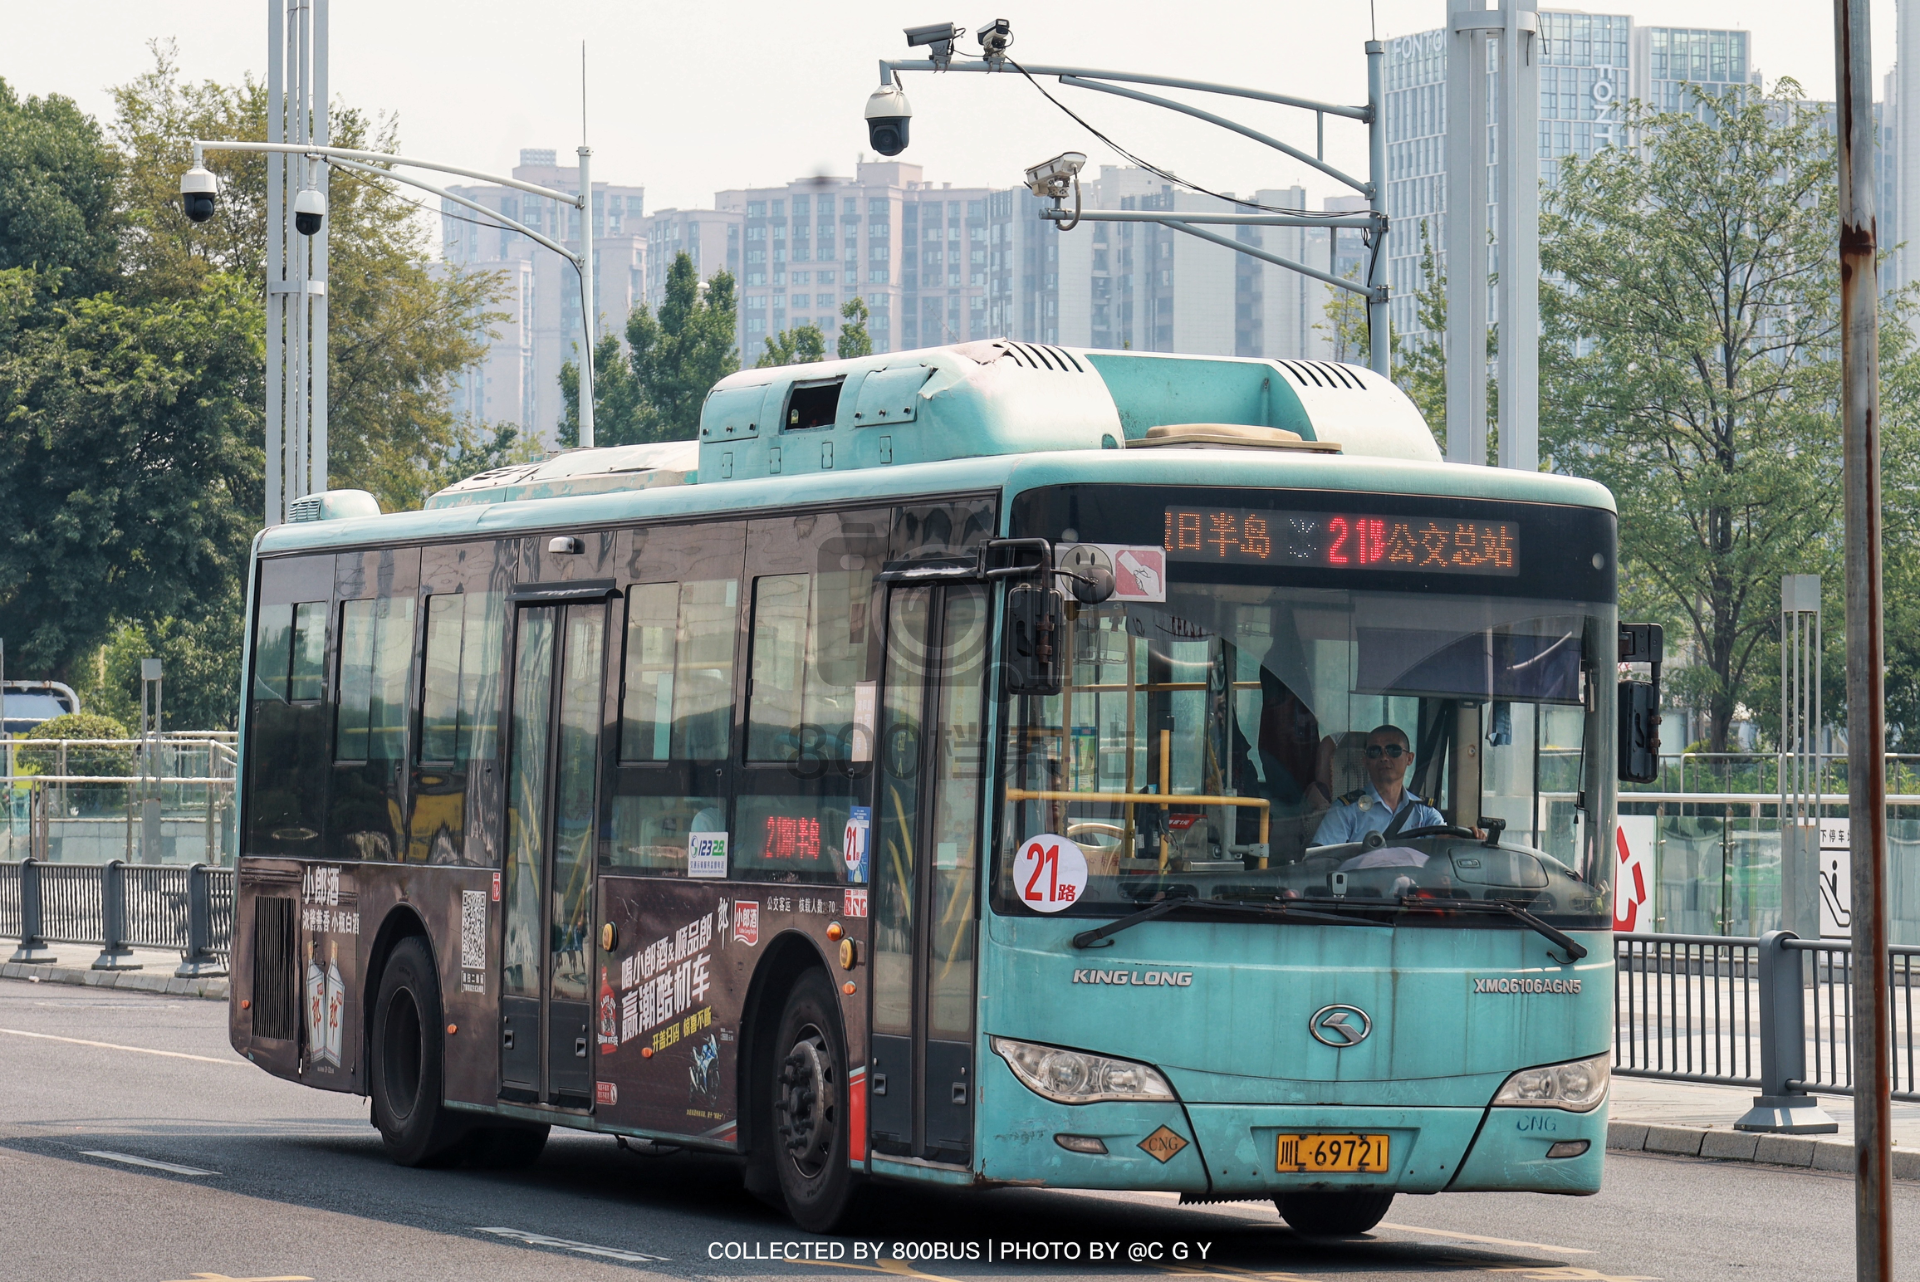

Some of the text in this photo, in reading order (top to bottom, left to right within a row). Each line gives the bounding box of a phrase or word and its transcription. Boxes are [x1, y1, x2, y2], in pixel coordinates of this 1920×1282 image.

[1393, 28, 1447, 60] FONTO
[1387, 522, 1514, 567] 公交总站
[1025, 842, 1076, 902] 21路
[302, 865, 340, 907] 小郎酒
[767, 896, 791, 912] 公交客运
[331, 910, 360, 936] 小瓶白酒
[735, 906, 758, 929] 小郎酒
[621, 952, 712, 1044] 赢潮酷机车
[1474, 978, 1582, 994] XMQ6106AGN5
[1516, 1115, 1557, 1132] CNG
[1148, 1136, 1179, 1151] CNG
